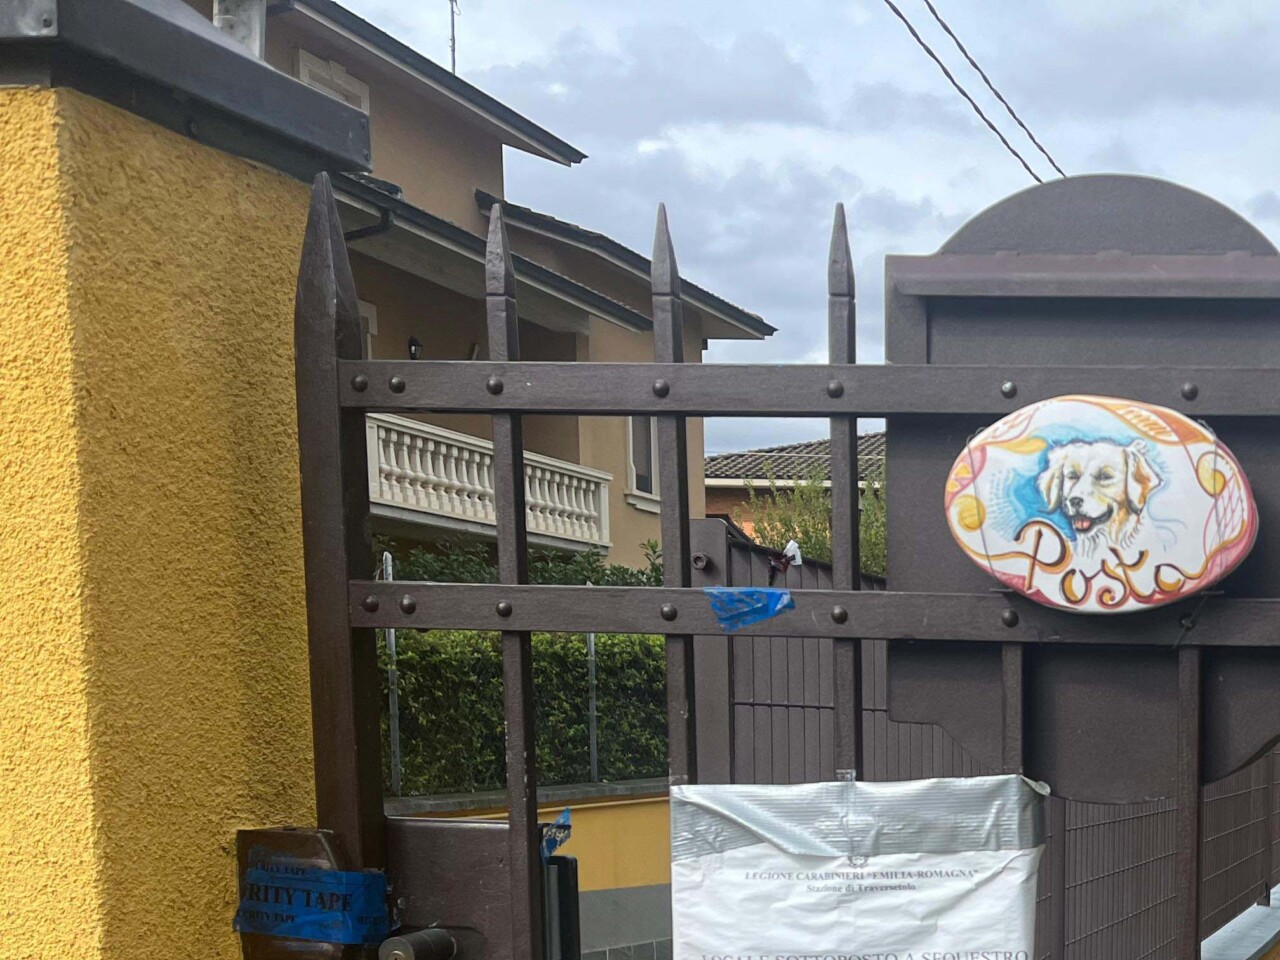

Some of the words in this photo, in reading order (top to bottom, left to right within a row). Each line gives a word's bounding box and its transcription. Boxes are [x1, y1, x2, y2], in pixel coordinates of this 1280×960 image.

[1014, 519, 1188, 609] Posta
[744, 871, 794, 881] LEGIONE
[796, 871, 865, 881] CARABINIERI
[806, 883, 843, 893] Stazione
[845, 883, 856, 893] di
[858, 883, 917, 893] Traversetolo
[302, 889, 352, 912] TAPE
